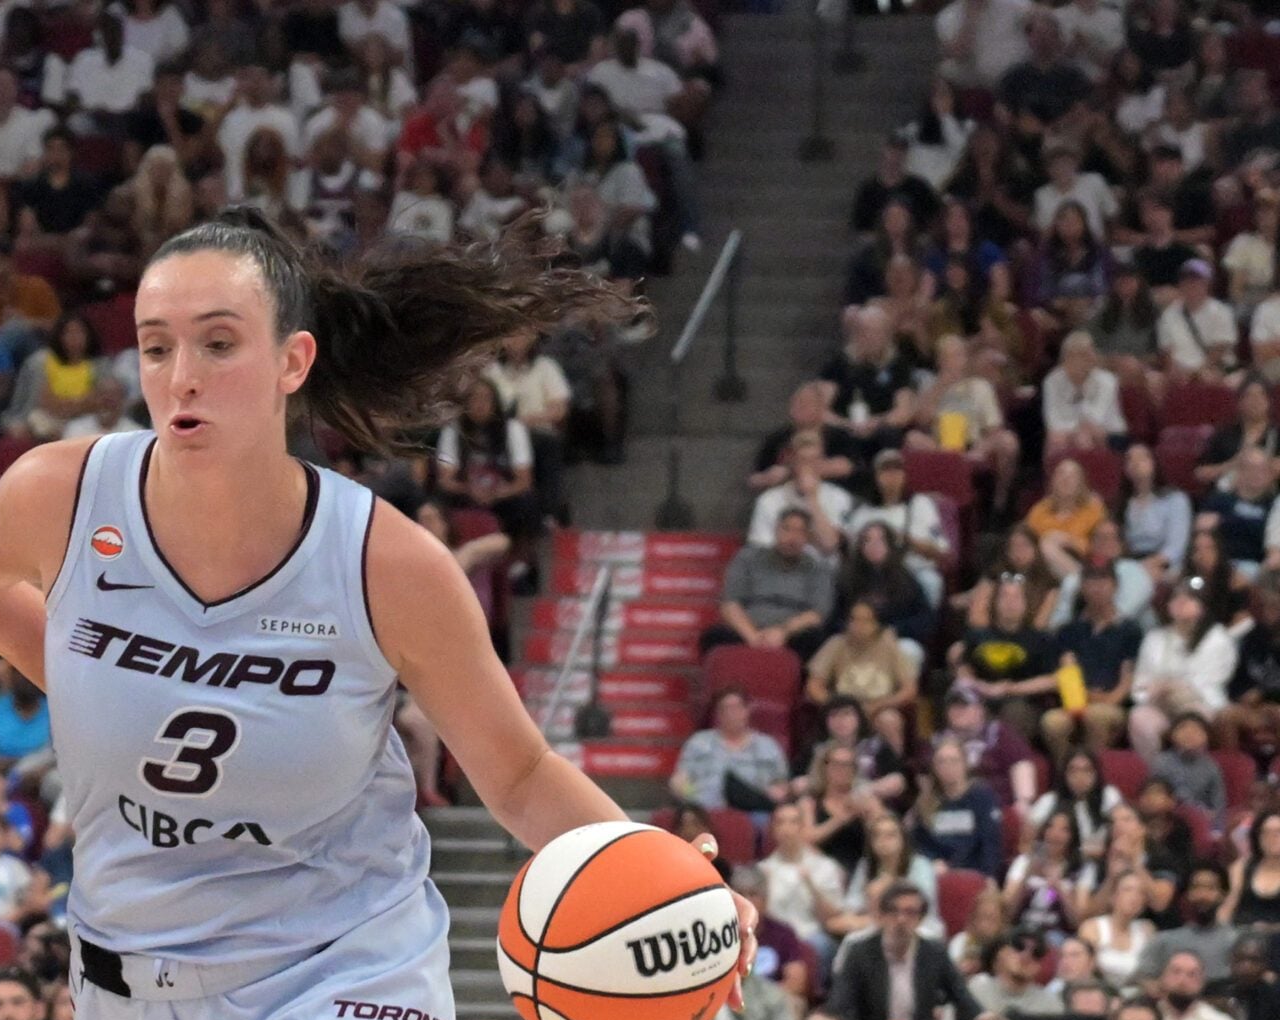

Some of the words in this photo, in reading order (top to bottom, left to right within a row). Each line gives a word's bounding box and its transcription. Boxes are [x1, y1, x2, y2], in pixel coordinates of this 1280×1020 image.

[68, 617, 336, 696] TEMPO
[261, 618, 337, 636] SEPHORA
[139, 707, 241, 799] 3
[117, 795, 215, 849] CIBC
